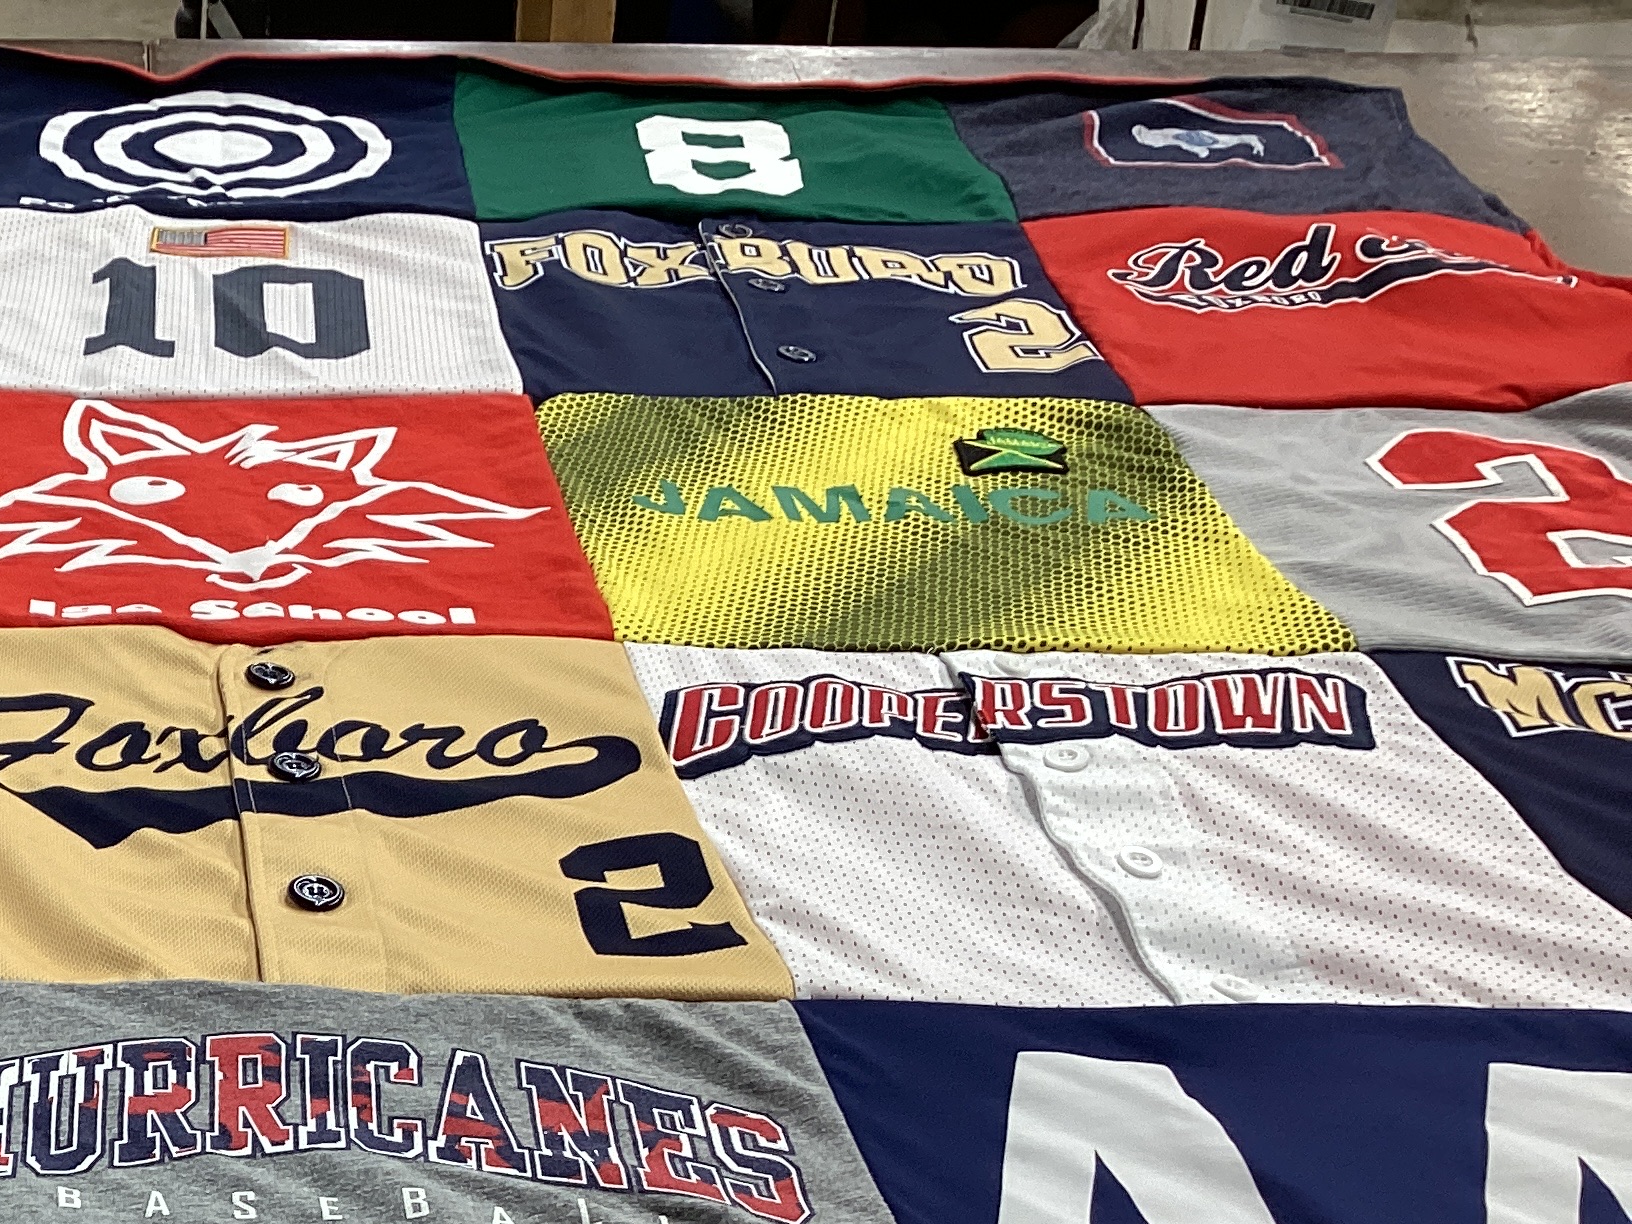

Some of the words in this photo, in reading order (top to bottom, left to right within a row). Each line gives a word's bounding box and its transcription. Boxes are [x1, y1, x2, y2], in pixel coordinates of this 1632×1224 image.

[636, 115, 803, 195] 8
[1107, 223, 1340, 293] Red
[83, 257, 371, 360] 10
[948, 298, 1104, 373] 2
[632, 479, 1158, 524] JAMAICA
[1366, 428, 1632, 606] 2
[664, 669, 1375, 779] COOPERSTOWN
[559, 833, 749, 957] 2
